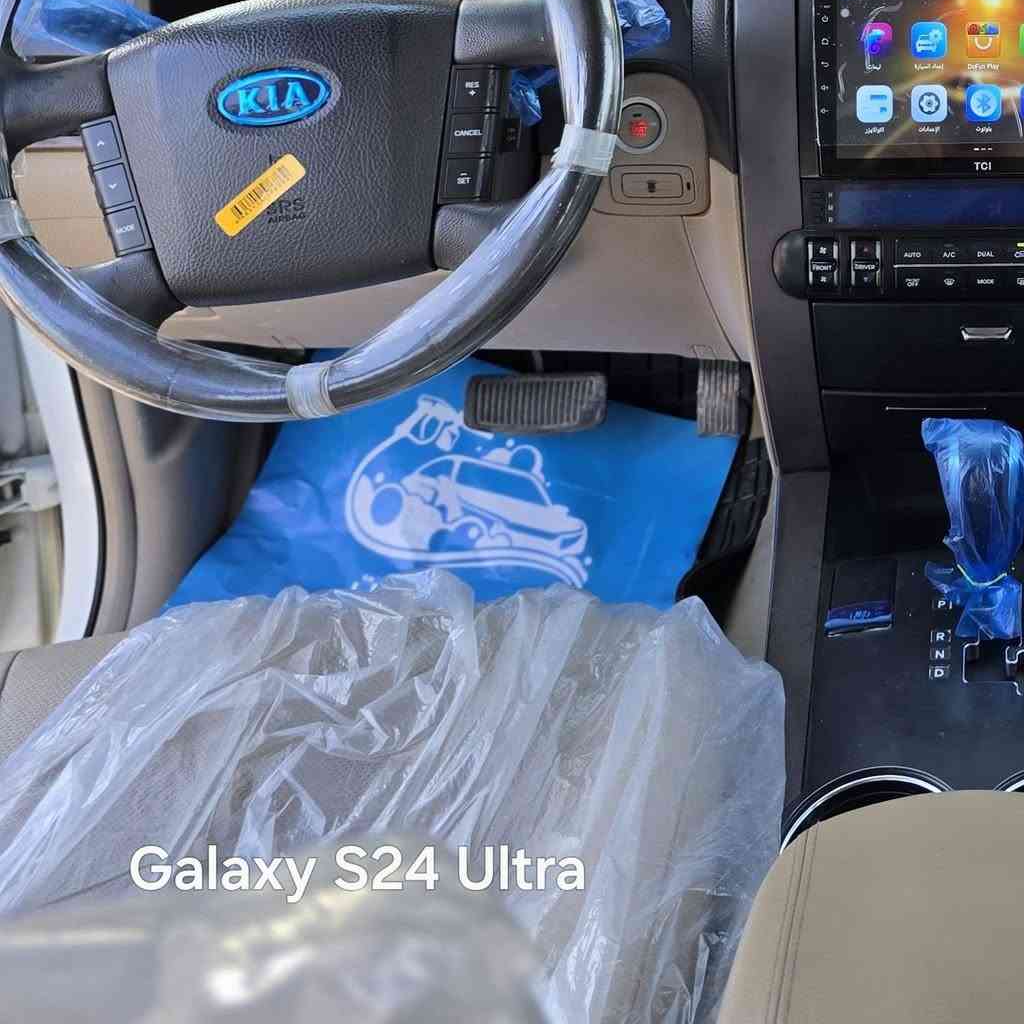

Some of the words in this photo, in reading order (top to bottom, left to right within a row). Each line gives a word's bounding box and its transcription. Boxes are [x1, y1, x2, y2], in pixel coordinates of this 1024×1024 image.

[465, 81, 480, 89] RES
[238, 81, 312, 116] KIA
[974, 161, 992, 171] TCI
[938, 600, 946, 608] P
[936, 632, 945, 641] R
[935, 650, 945, 659] N
[934, 669, 944, 678] D
